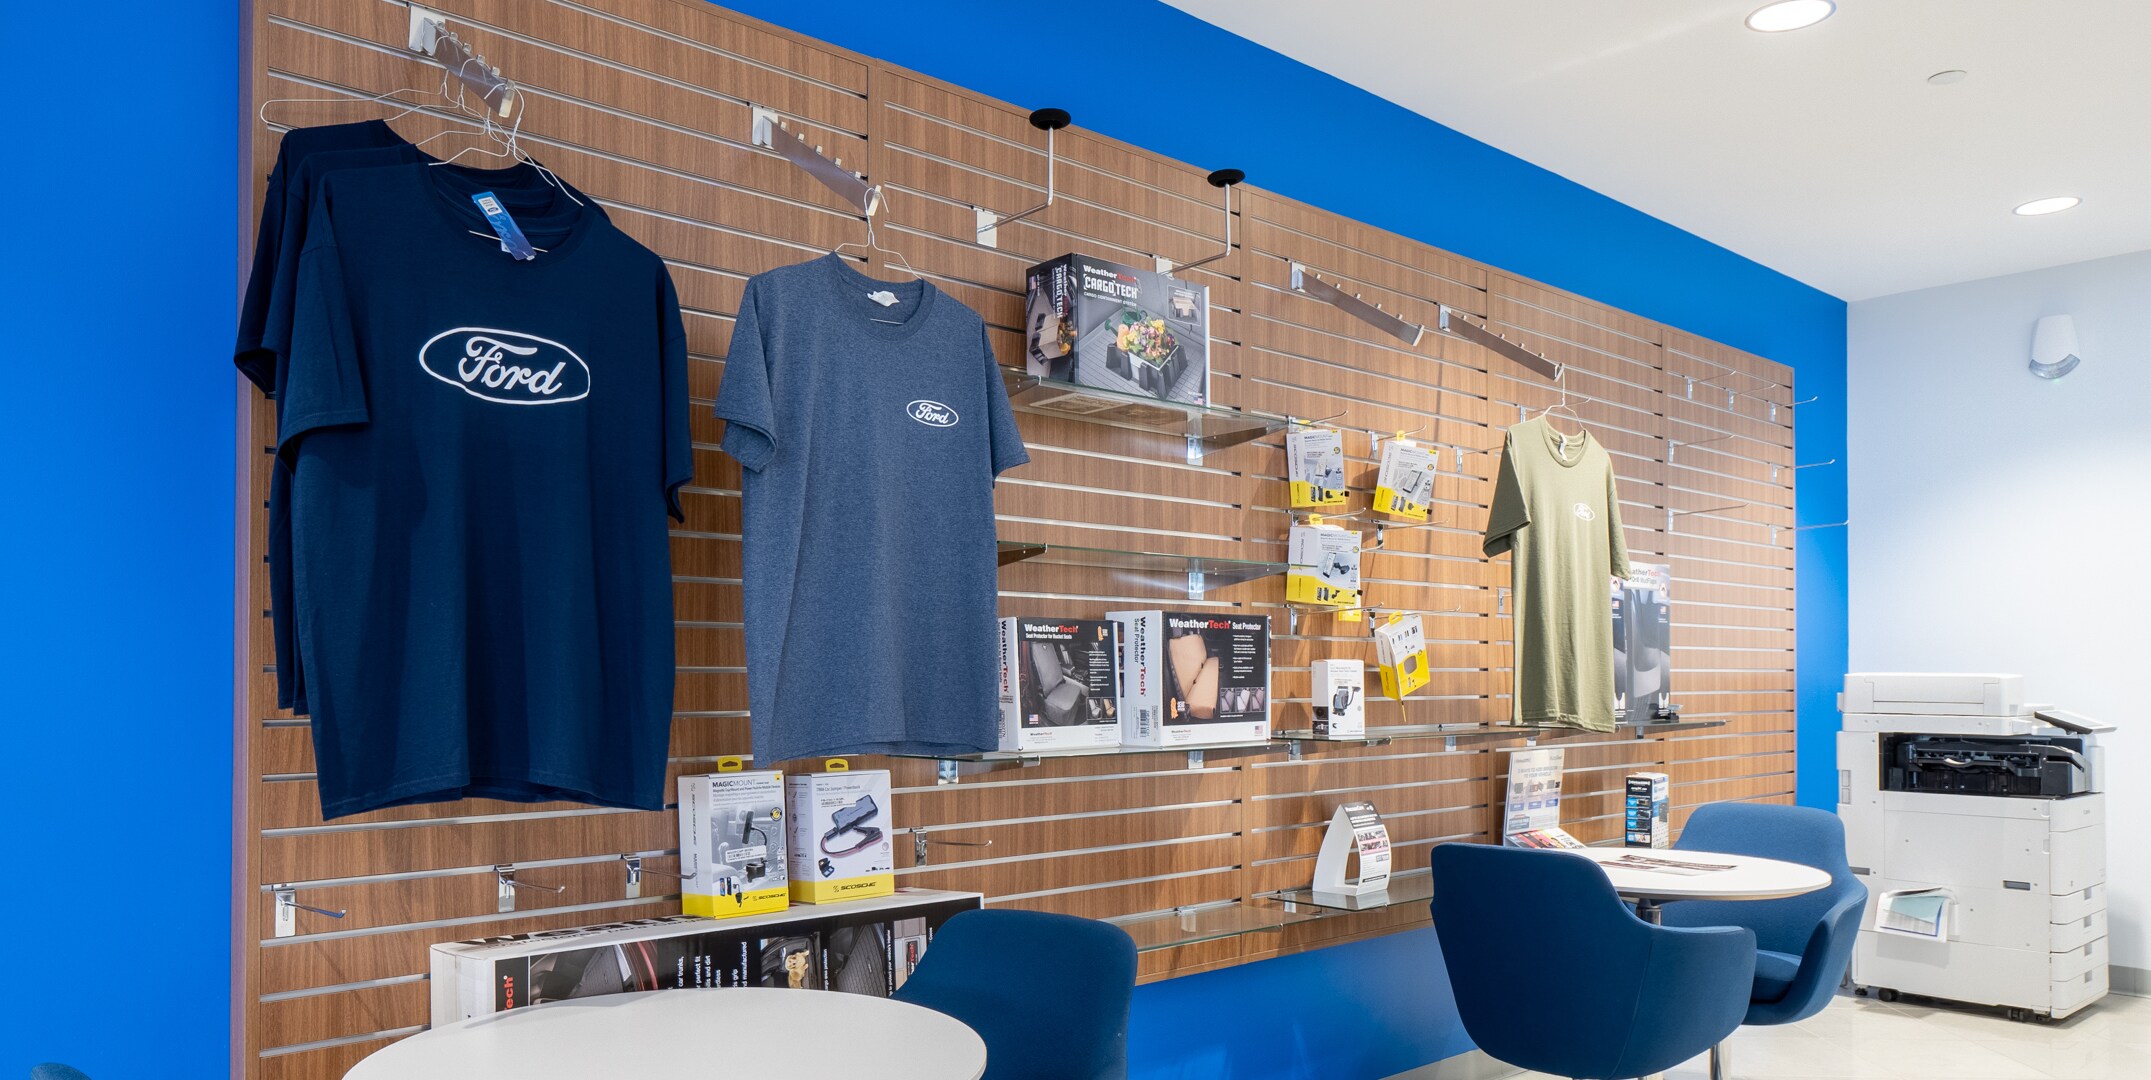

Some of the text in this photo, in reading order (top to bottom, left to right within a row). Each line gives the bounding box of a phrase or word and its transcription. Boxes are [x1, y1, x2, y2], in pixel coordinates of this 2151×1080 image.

[458, 336, 566, 394] Ford
[915, 402, 949, 424] Ford
[1024, 624, 1078, 633] WeatherTech
[1169, 619, 1230, 629] WeatherTech
[1232, 622, 1242, 630] Seat
[1001, 620, 1009, 694] WeatherTech
[712, 780, 755, 788] MAGICMOUNT
[841, 881, 877, 891] SCOSCHE
[504, 977, 514, 1009] ech
